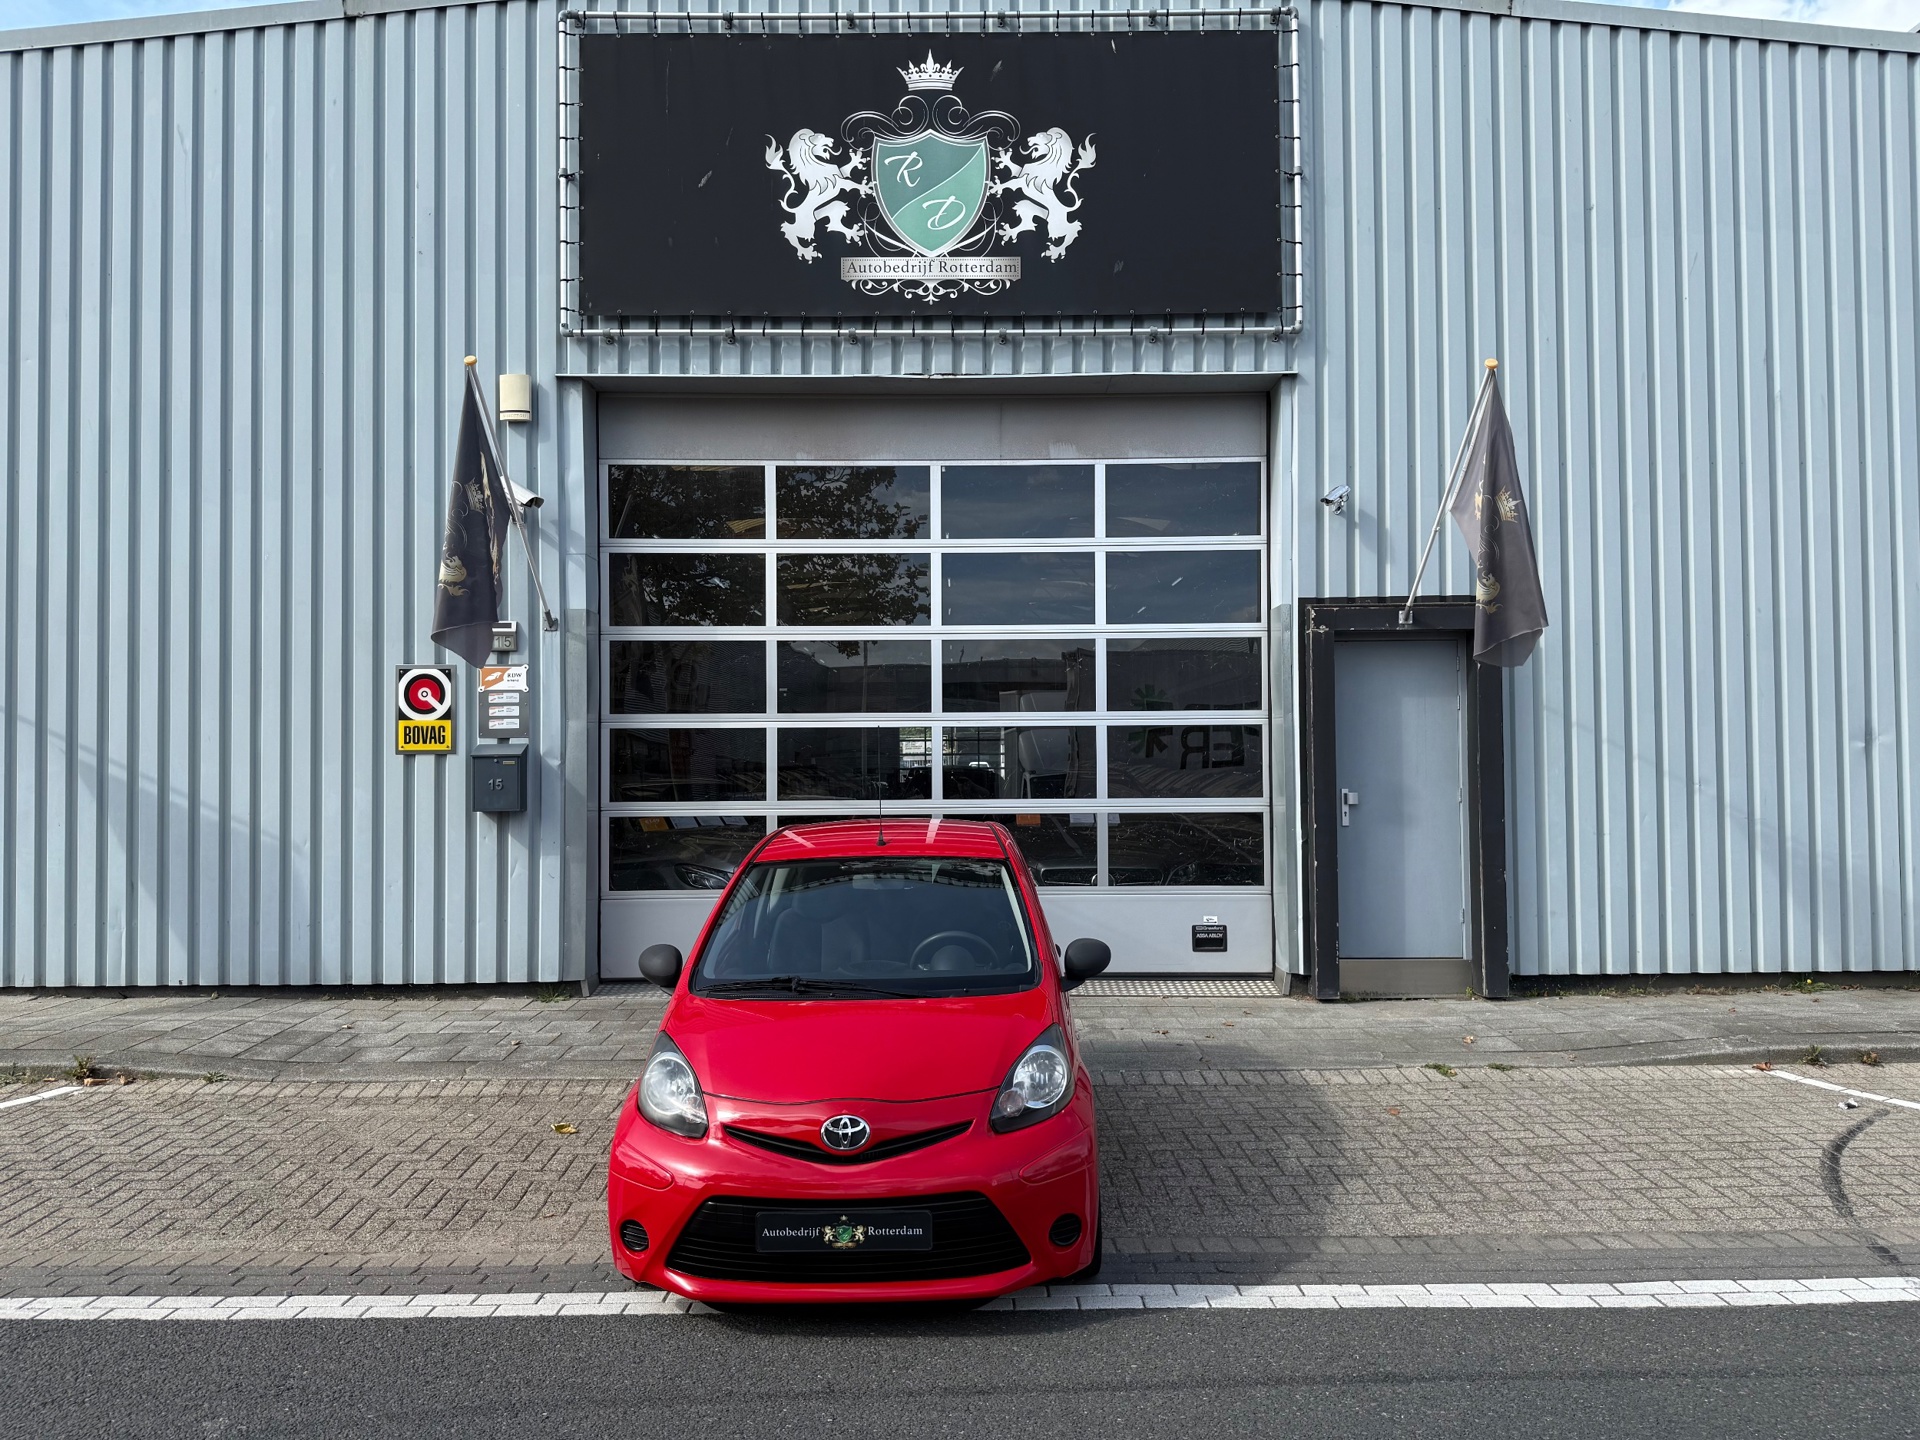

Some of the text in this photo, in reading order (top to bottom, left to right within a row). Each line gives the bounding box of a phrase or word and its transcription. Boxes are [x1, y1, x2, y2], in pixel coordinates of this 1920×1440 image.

[884, 151, 923, 187] R
[847, 260, 1018, 277] Autobedrijf Rotterdam
[495, 636, 511, 648] 15
[404, 726, 446, 745] BOVAG
[488, 779, 503, 790] 15
[762, 1226, 923, 1238] Autobedrijf Rotterdam
